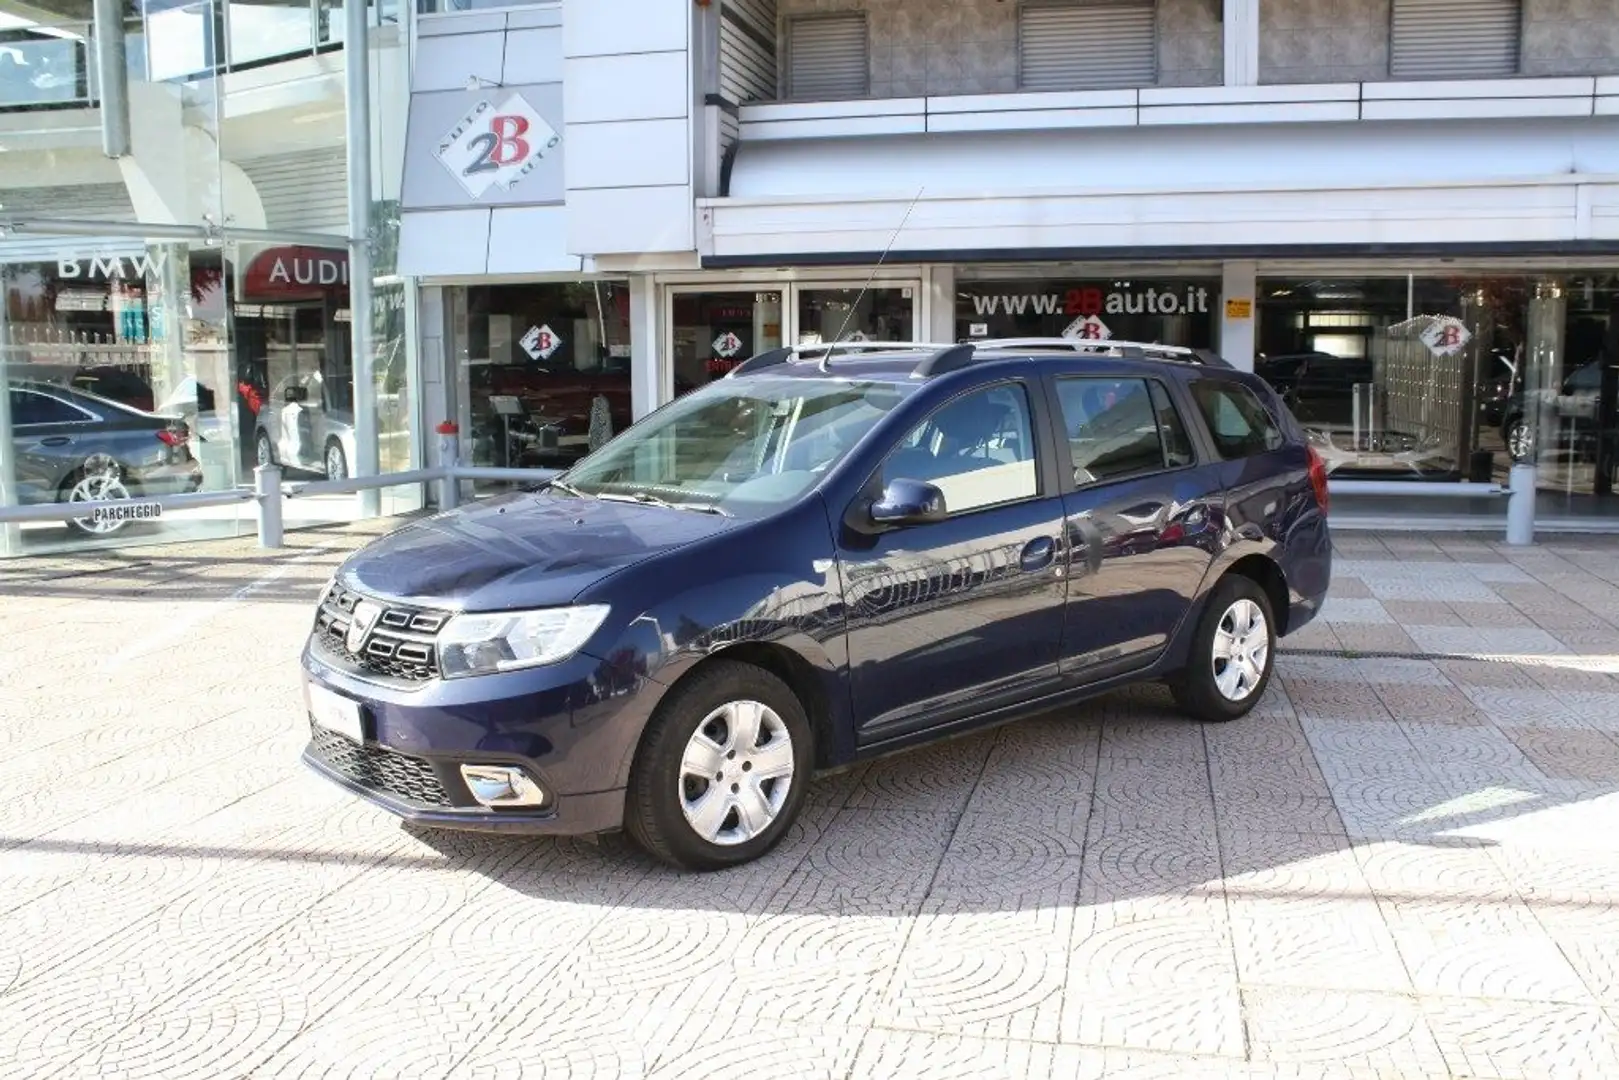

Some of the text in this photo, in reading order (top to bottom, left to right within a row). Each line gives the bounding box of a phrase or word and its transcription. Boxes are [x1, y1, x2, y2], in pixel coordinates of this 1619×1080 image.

[439, 101, 488, 155] AUTO
[463, 115, 530, 176] 2B
[508, 136, 560, 190] AUTO
[57, 250, 167, 279] BMW
[268, 257, 348, 285] AUDI
[94, 503, 161, 520] PARCHEGGIO
